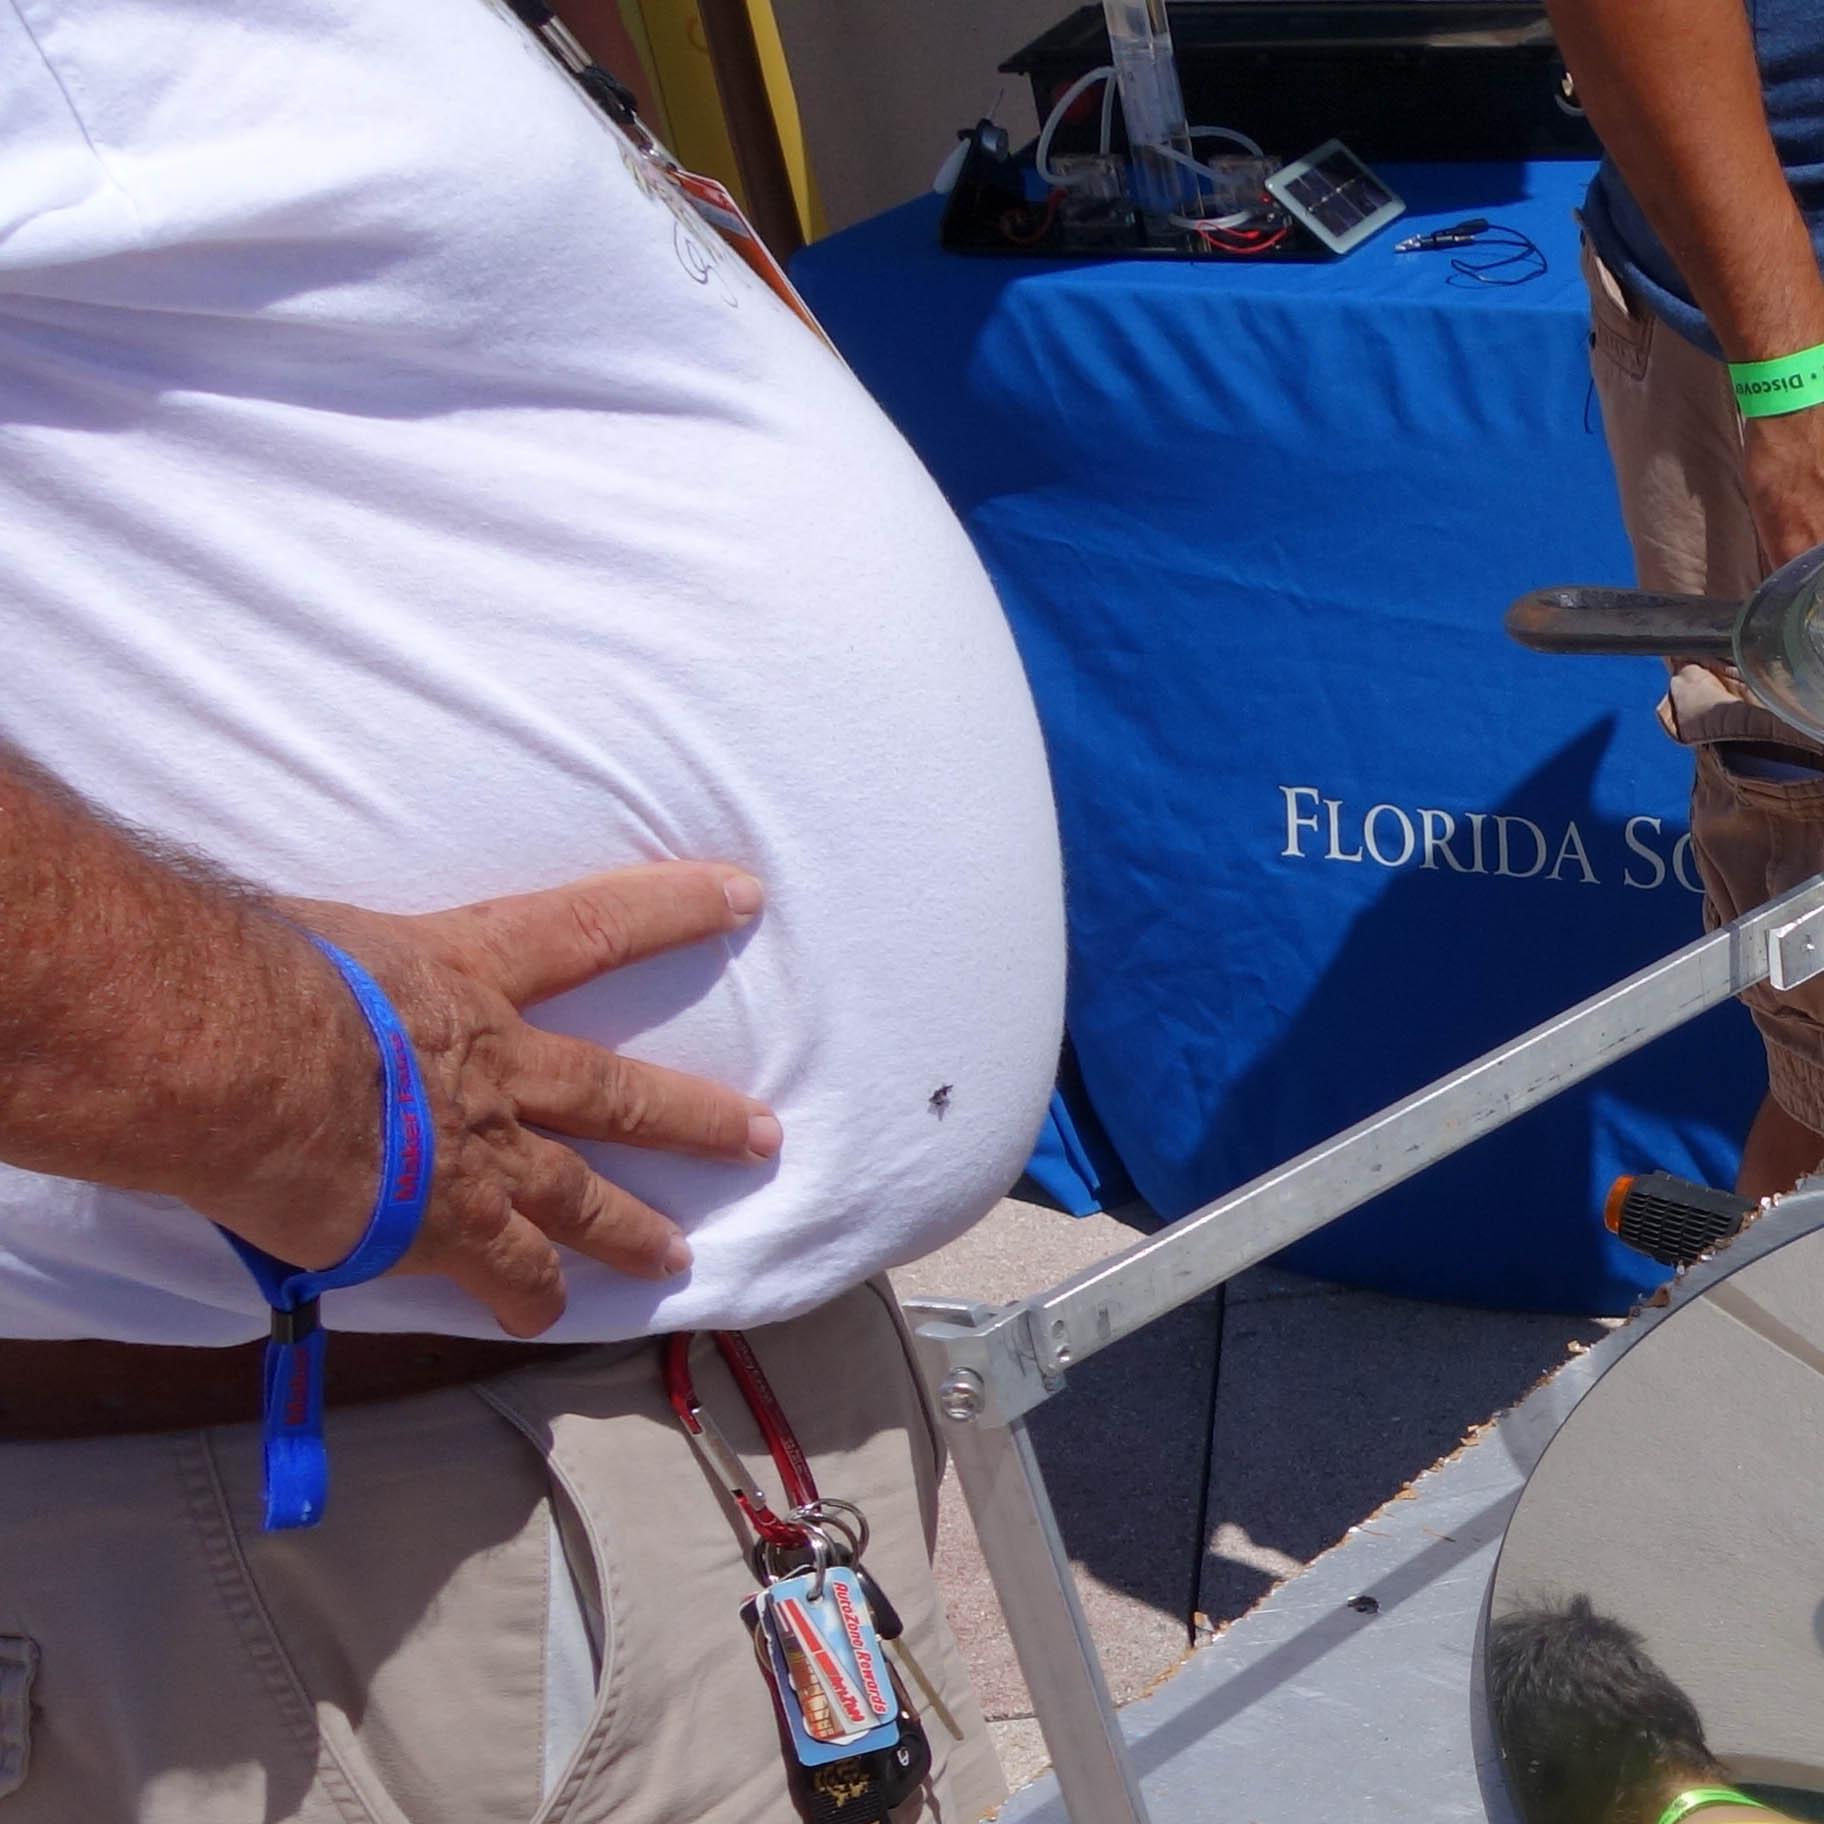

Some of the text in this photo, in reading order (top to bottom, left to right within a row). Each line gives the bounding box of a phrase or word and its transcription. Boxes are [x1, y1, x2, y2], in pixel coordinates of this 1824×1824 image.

[1279, 785, 1601, 885] FLORIDA
[395, 1113, 422, 1201] Maker
[831, 1580, 889, 1715] AutoZone Rewards
